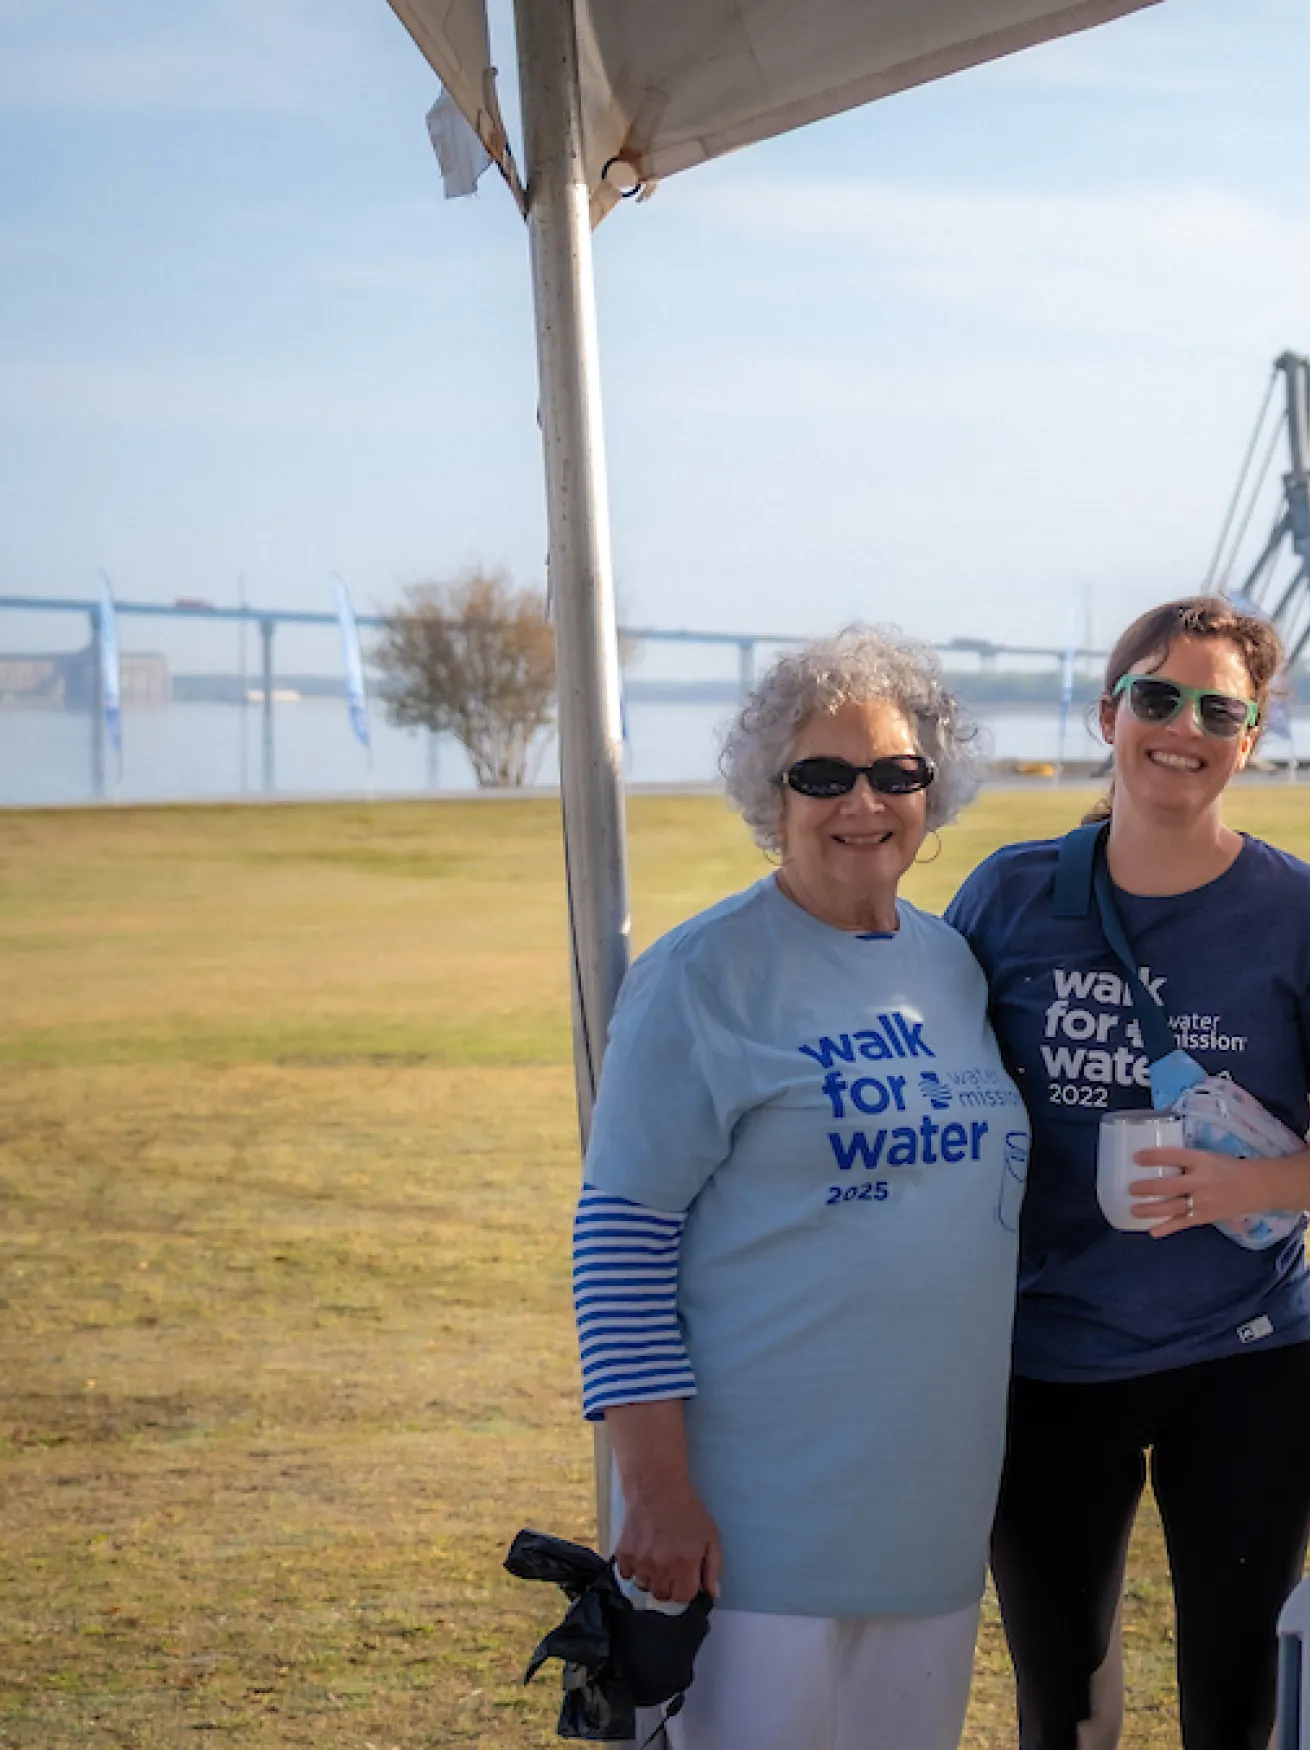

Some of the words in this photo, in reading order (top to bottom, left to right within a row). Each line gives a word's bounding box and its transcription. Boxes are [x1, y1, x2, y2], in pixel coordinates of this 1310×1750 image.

[798, 1011, 936, 1068] walk
[1044, 1000, 1118, 1043] for
[1039, 1046, 1151, 1088] wate
[821, 1070, 907, 1118] for
[1049, 1083, 1109, 1108] 2022
[828, 1115, 989, 1170] water
[826, 1181, 890, 1206] 2025
